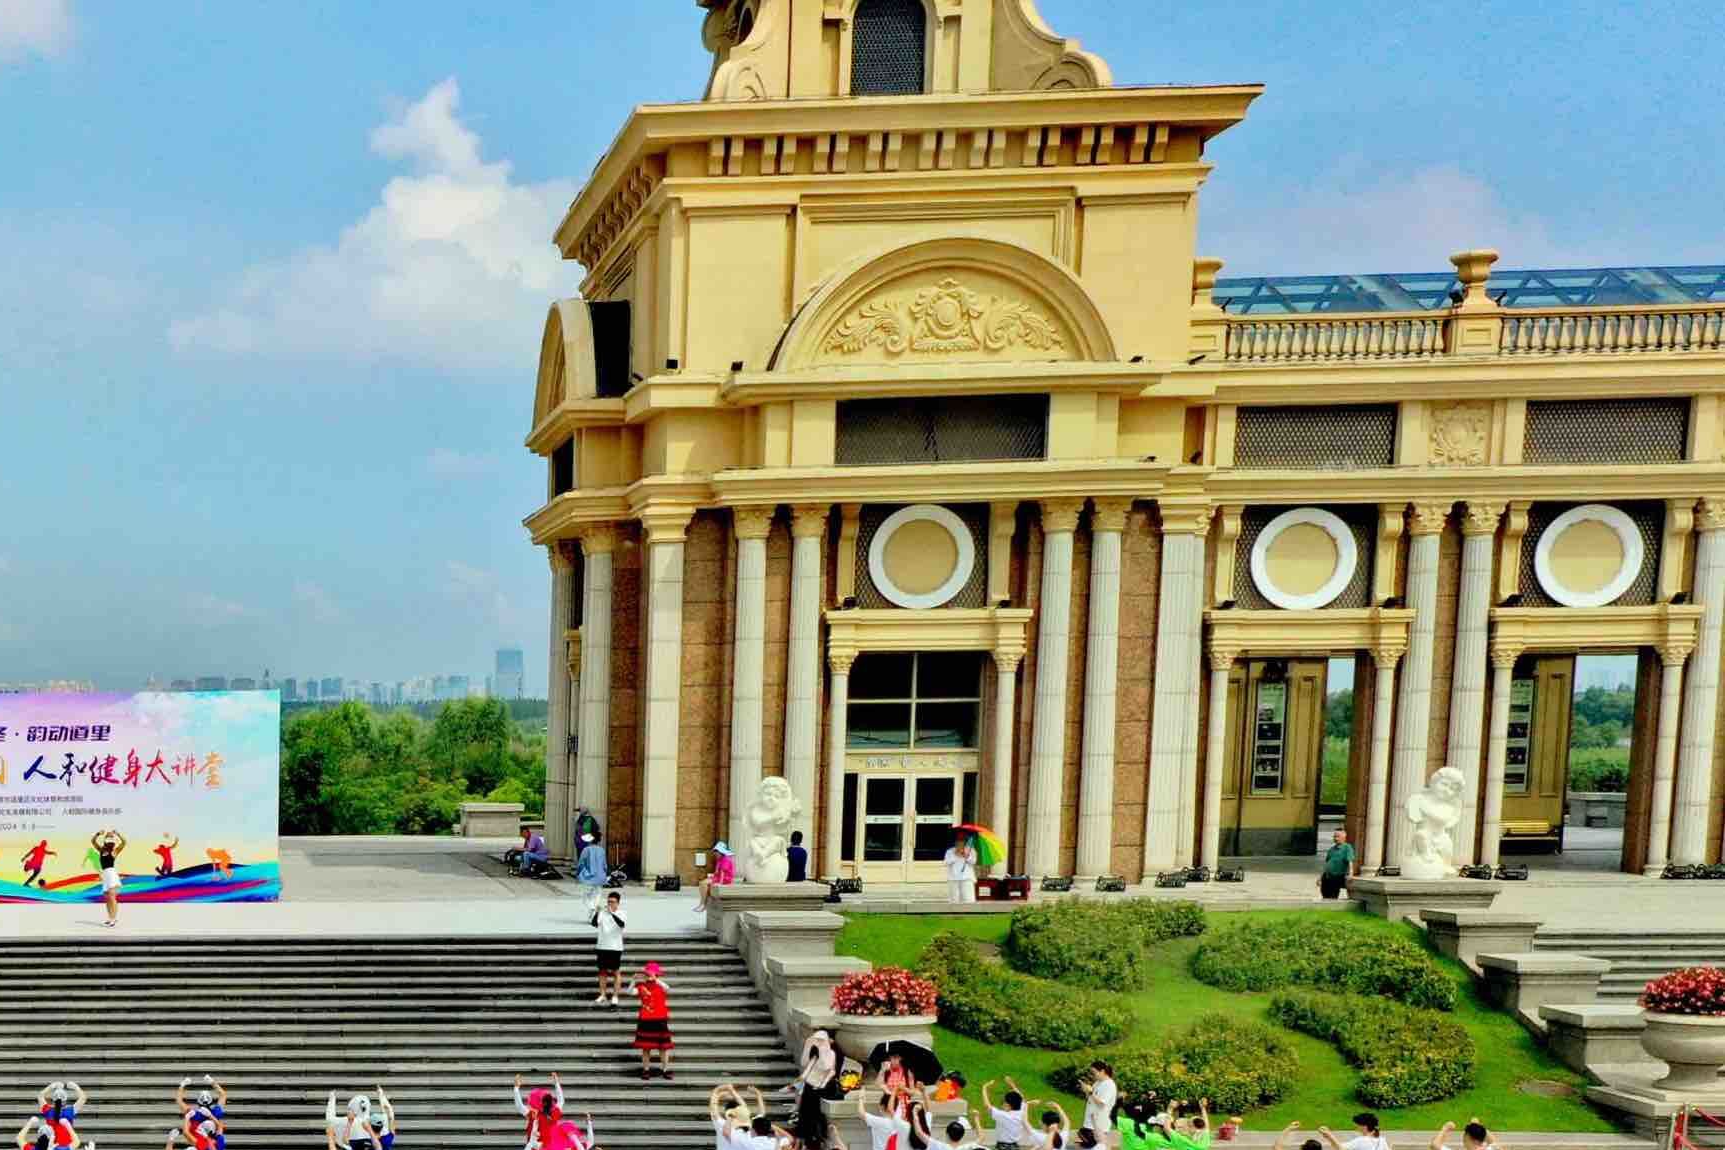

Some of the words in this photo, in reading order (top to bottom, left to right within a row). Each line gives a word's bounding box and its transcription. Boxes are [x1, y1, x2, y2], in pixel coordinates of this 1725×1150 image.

[23, 748, 225, 788] 人和健身大讲堂
